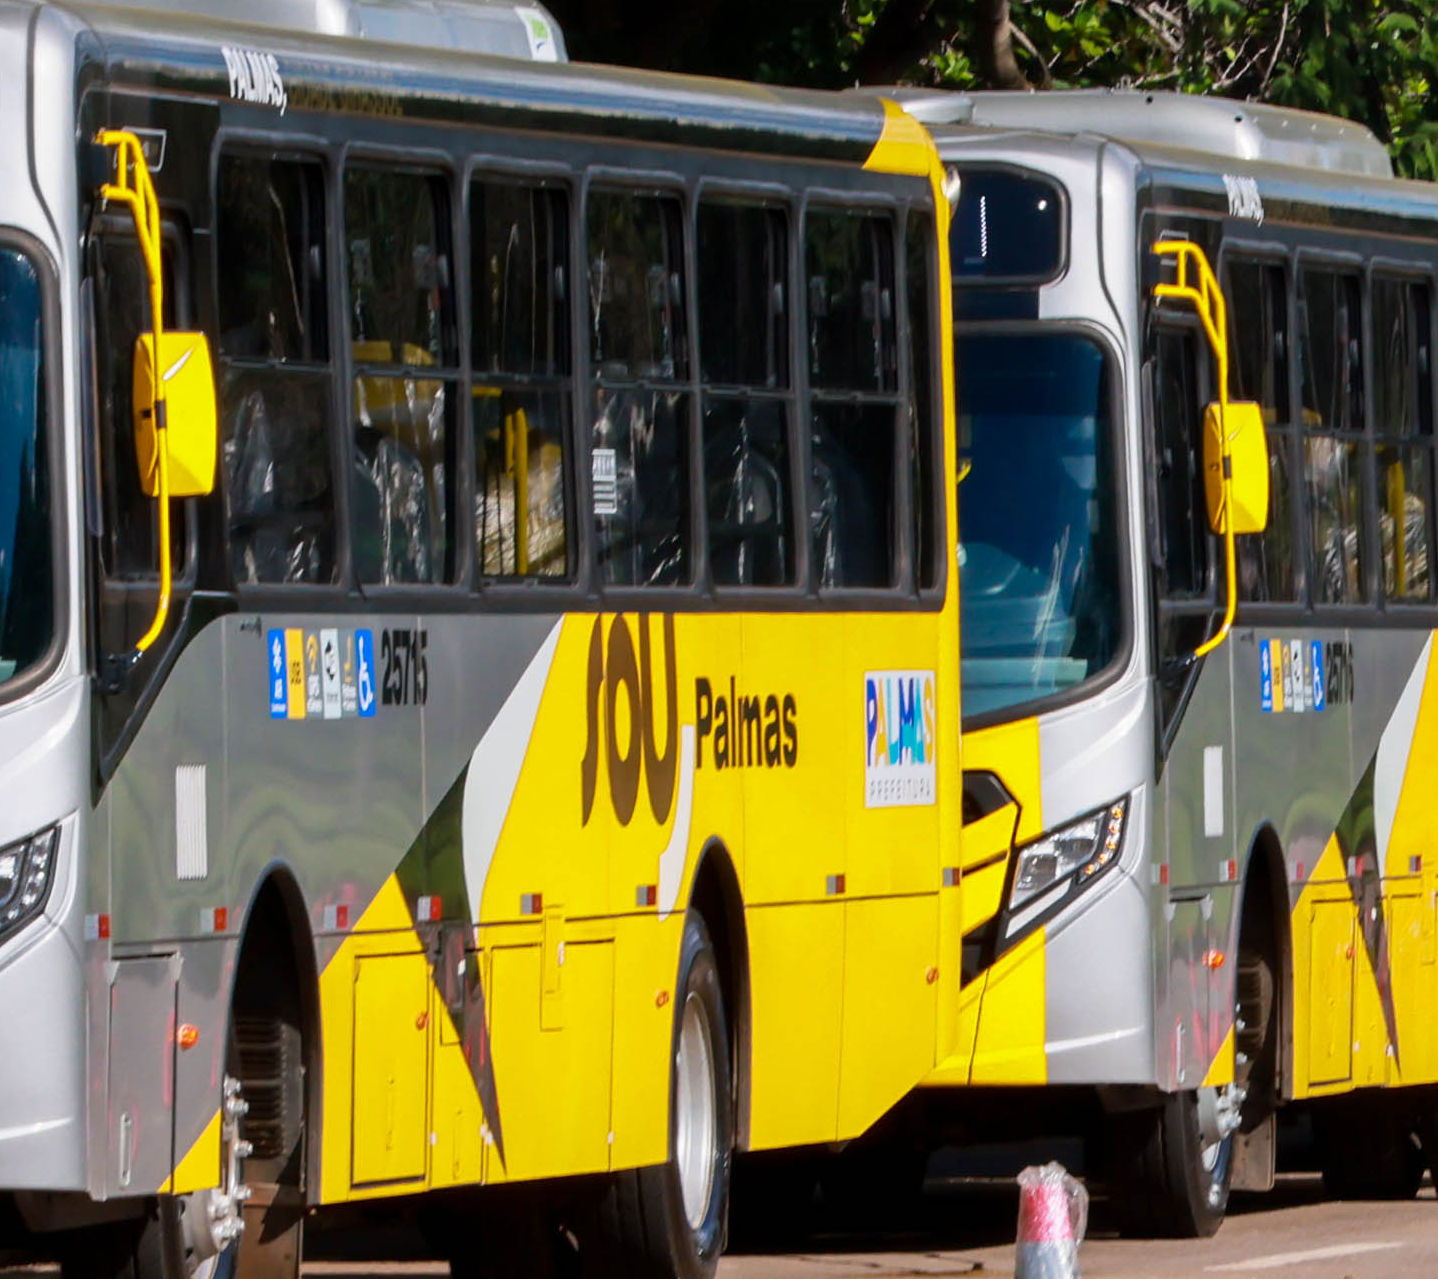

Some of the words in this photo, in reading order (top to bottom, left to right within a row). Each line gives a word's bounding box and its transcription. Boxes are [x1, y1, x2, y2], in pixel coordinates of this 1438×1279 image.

[381, 628, 428, 706] 25715
[695, 675, 798, 771] Palmas
[866, 677, 934, 768] PALMAS
